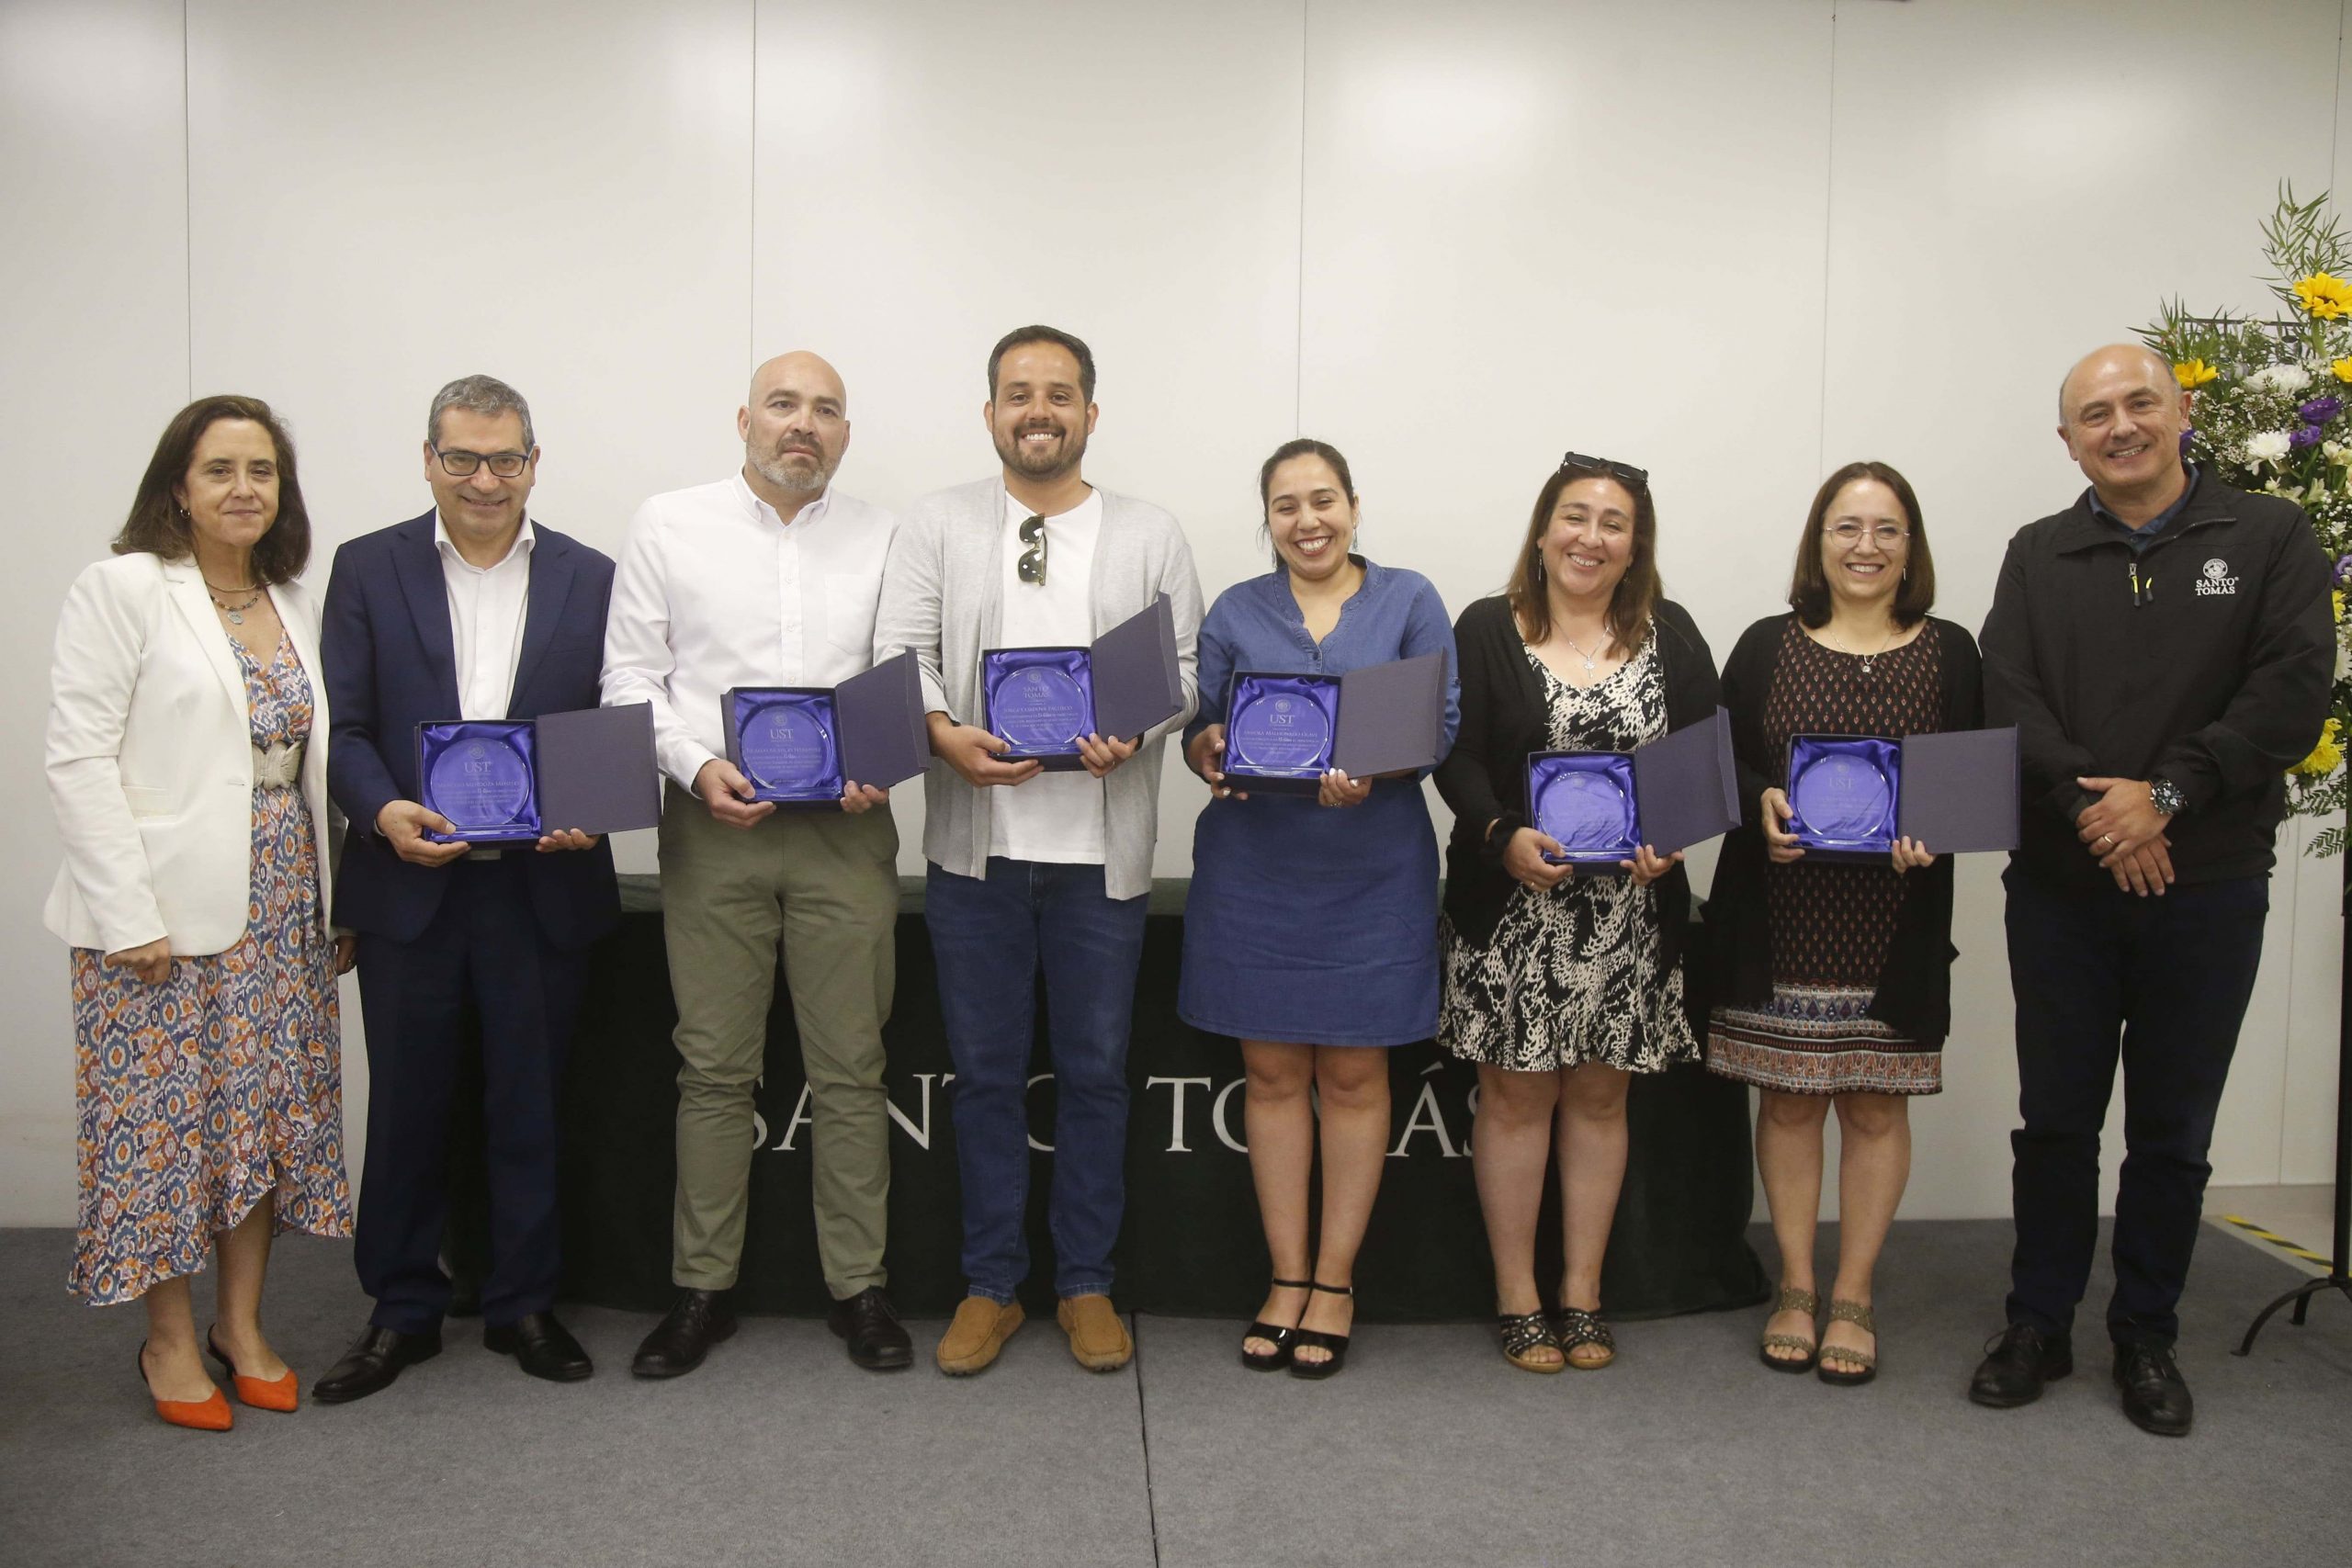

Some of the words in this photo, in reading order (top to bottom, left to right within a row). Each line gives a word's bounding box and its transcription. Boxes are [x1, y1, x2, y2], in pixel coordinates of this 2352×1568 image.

[2196, 578, 2235, 588] SANTO
[1270, 714, 1295, 724] UST
[770, 728, 794, 739] UST
[464, 761, 492, 773] UST
